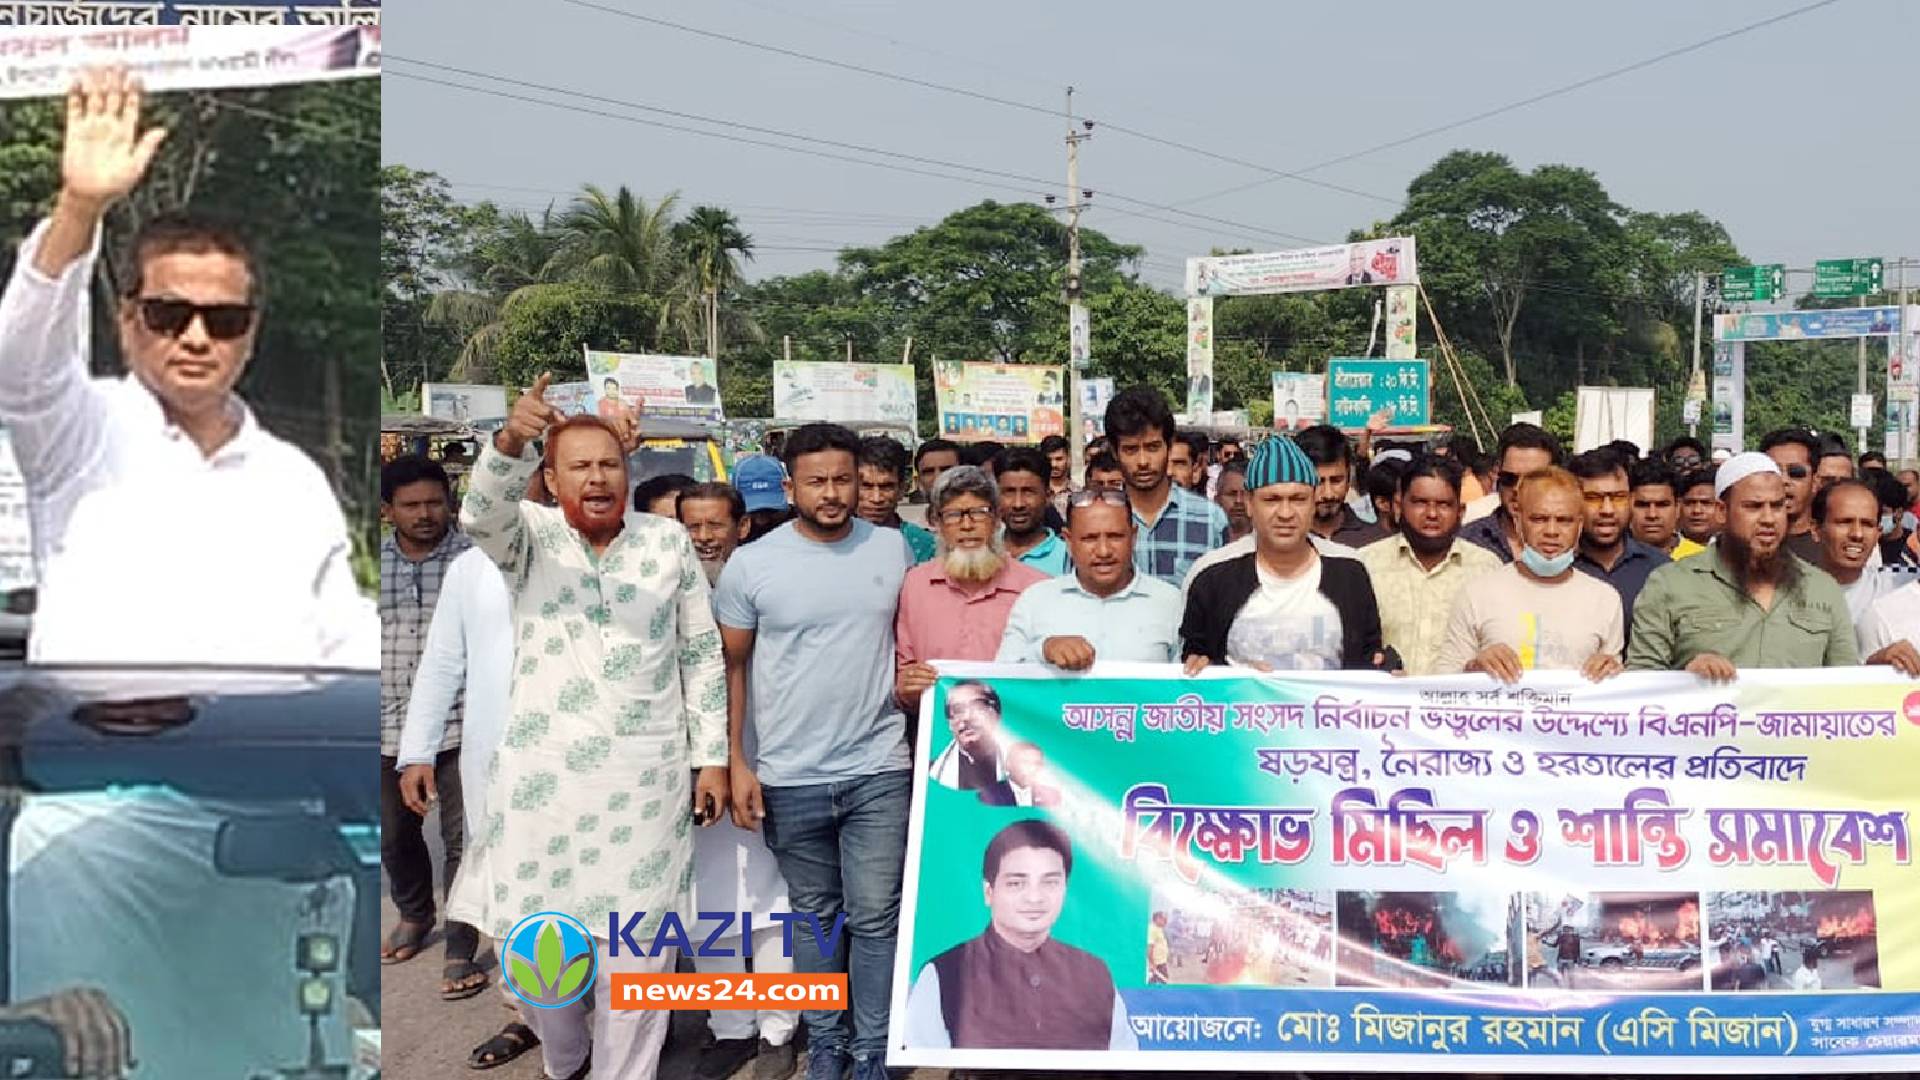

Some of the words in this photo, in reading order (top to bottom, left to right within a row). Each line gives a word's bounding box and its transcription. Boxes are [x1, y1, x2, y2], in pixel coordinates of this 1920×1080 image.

[1064, 703, 1136, 740] আসন্ন
[1144, 695, 1224, 732] জাতীয়
[1234, 704, 1306, 732] সংসদ
[1313, 696, 1410, 731] নির্বাচন
[1532, 706, 1630, 738] উদ্দেশ্যে
[1638, 704, 1897, 741] বিএনপি-জামায়াতের
[1381, 734, 1493, 778] নৈরাজ্য
[1502, 751, 1525, 777] ও
[1533, 751, 1678, 780] হরতালের
[1684, 746, 1809, 783] প্রতিবাদে
[1122, 784, 1318, 883] বিক্ষোভ
[1332, 786, 1491, 871] মিছিল
[1504, 808, 1542, 864] ও
[1557, 787, 1692, 868] শান্তি
[1704, 808, 1909, 886] সমাবেশ
[1350, 1003, 1472, 1051] মিজানুর
[1480, 1013, 1585, 1049] রহমান
[1596, 1007, 1680, 1055] (এসি
[1686, 1007, 1799, 1055] মিজান)
